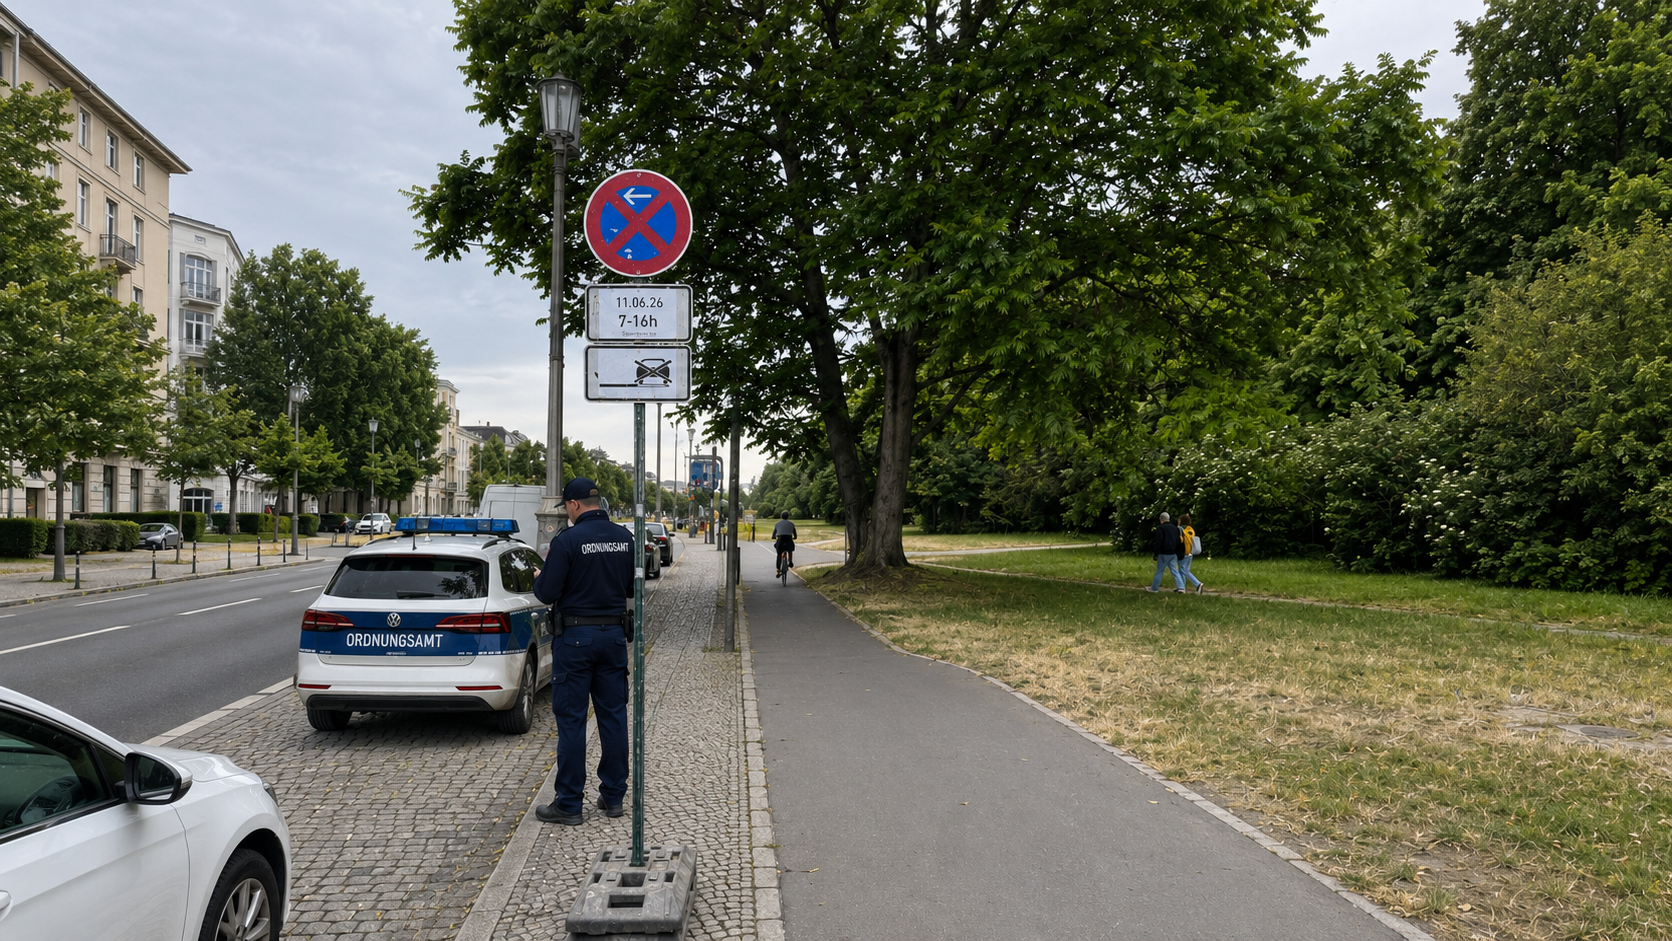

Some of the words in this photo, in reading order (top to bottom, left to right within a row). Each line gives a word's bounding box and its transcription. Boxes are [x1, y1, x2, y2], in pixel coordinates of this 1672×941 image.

[616, 297, 663, 308] 11.06.26
[618, 314, 658, 328] 7-16h
[581, 542, 629, 555] ORDNUNGSAMT
[346, 633, 443, 648] ORDNUNGSAMT
